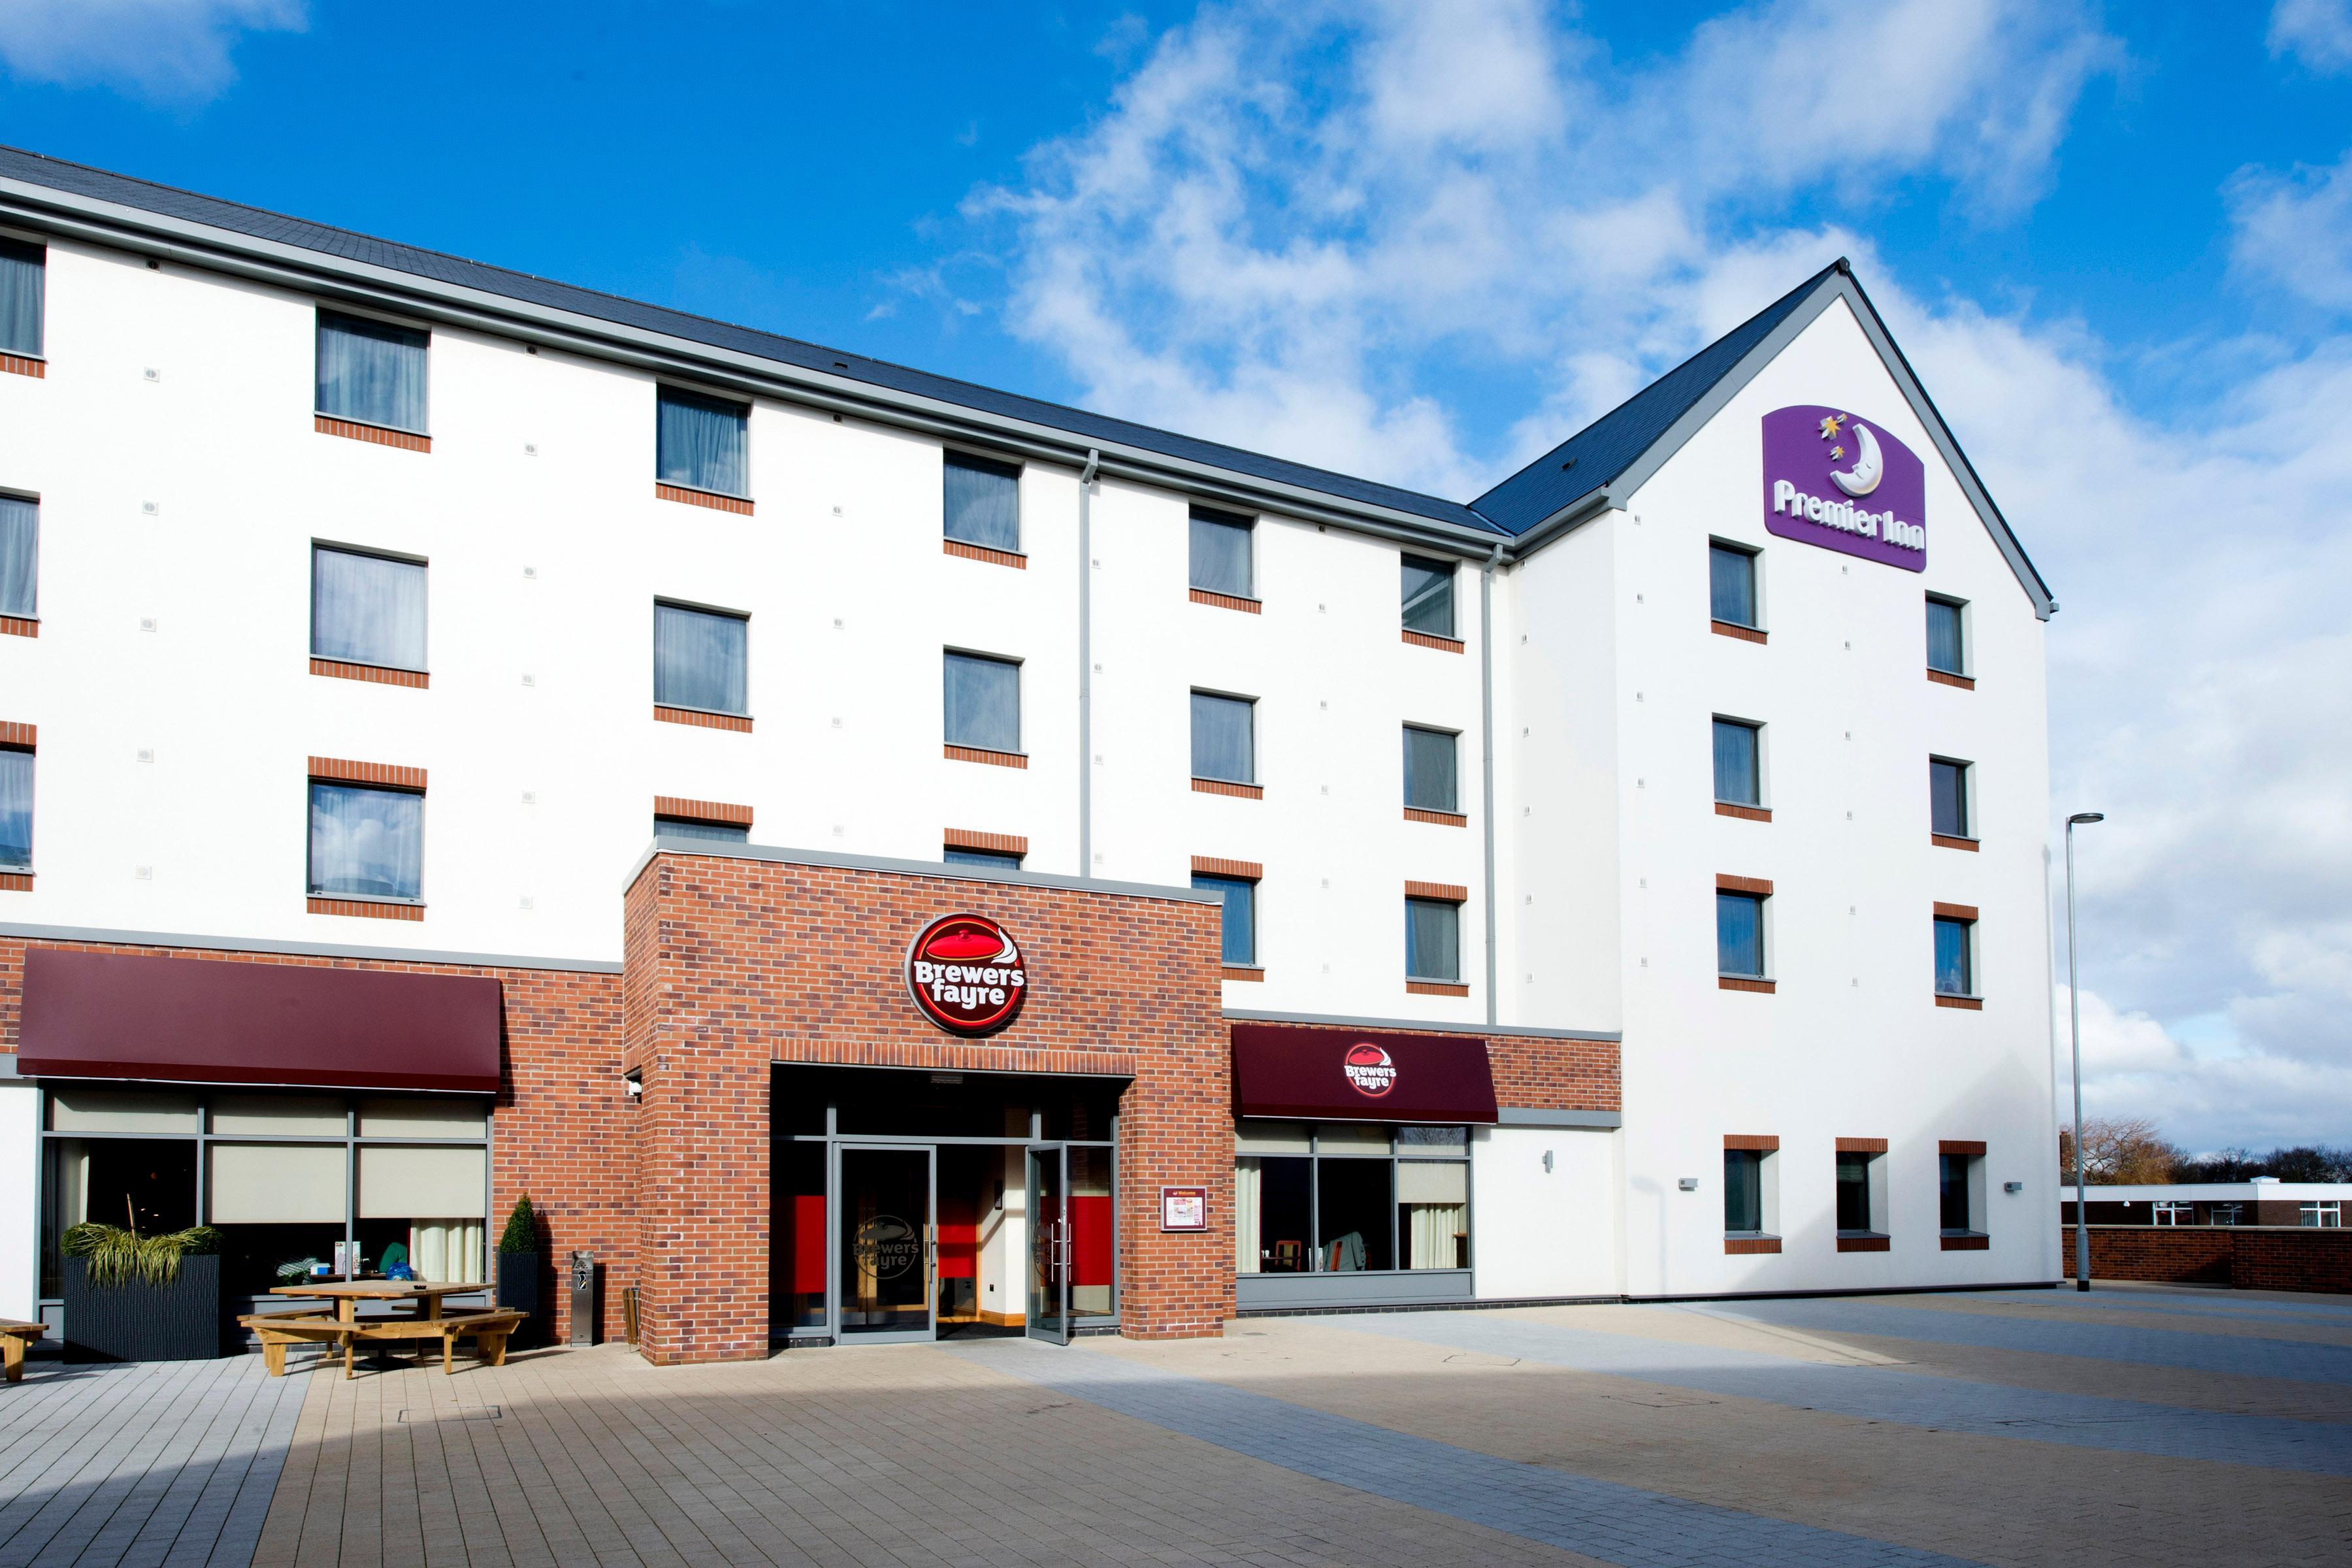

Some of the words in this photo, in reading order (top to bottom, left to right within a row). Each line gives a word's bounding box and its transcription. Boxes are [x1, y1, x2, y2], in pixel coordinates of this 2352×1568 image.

[1774, 480, 1882, 537] Premier
[1882, 510, 1925, 550] Inn
[913, 960, 1024, 987] Brewers
[932, 977, 1005, 1009] fayre
[1344, 1066, 1396, 1077] Brewers
[1354, 1073, 1389, 1089] fayre
[853, 1243, 919, 1255] Brewers
